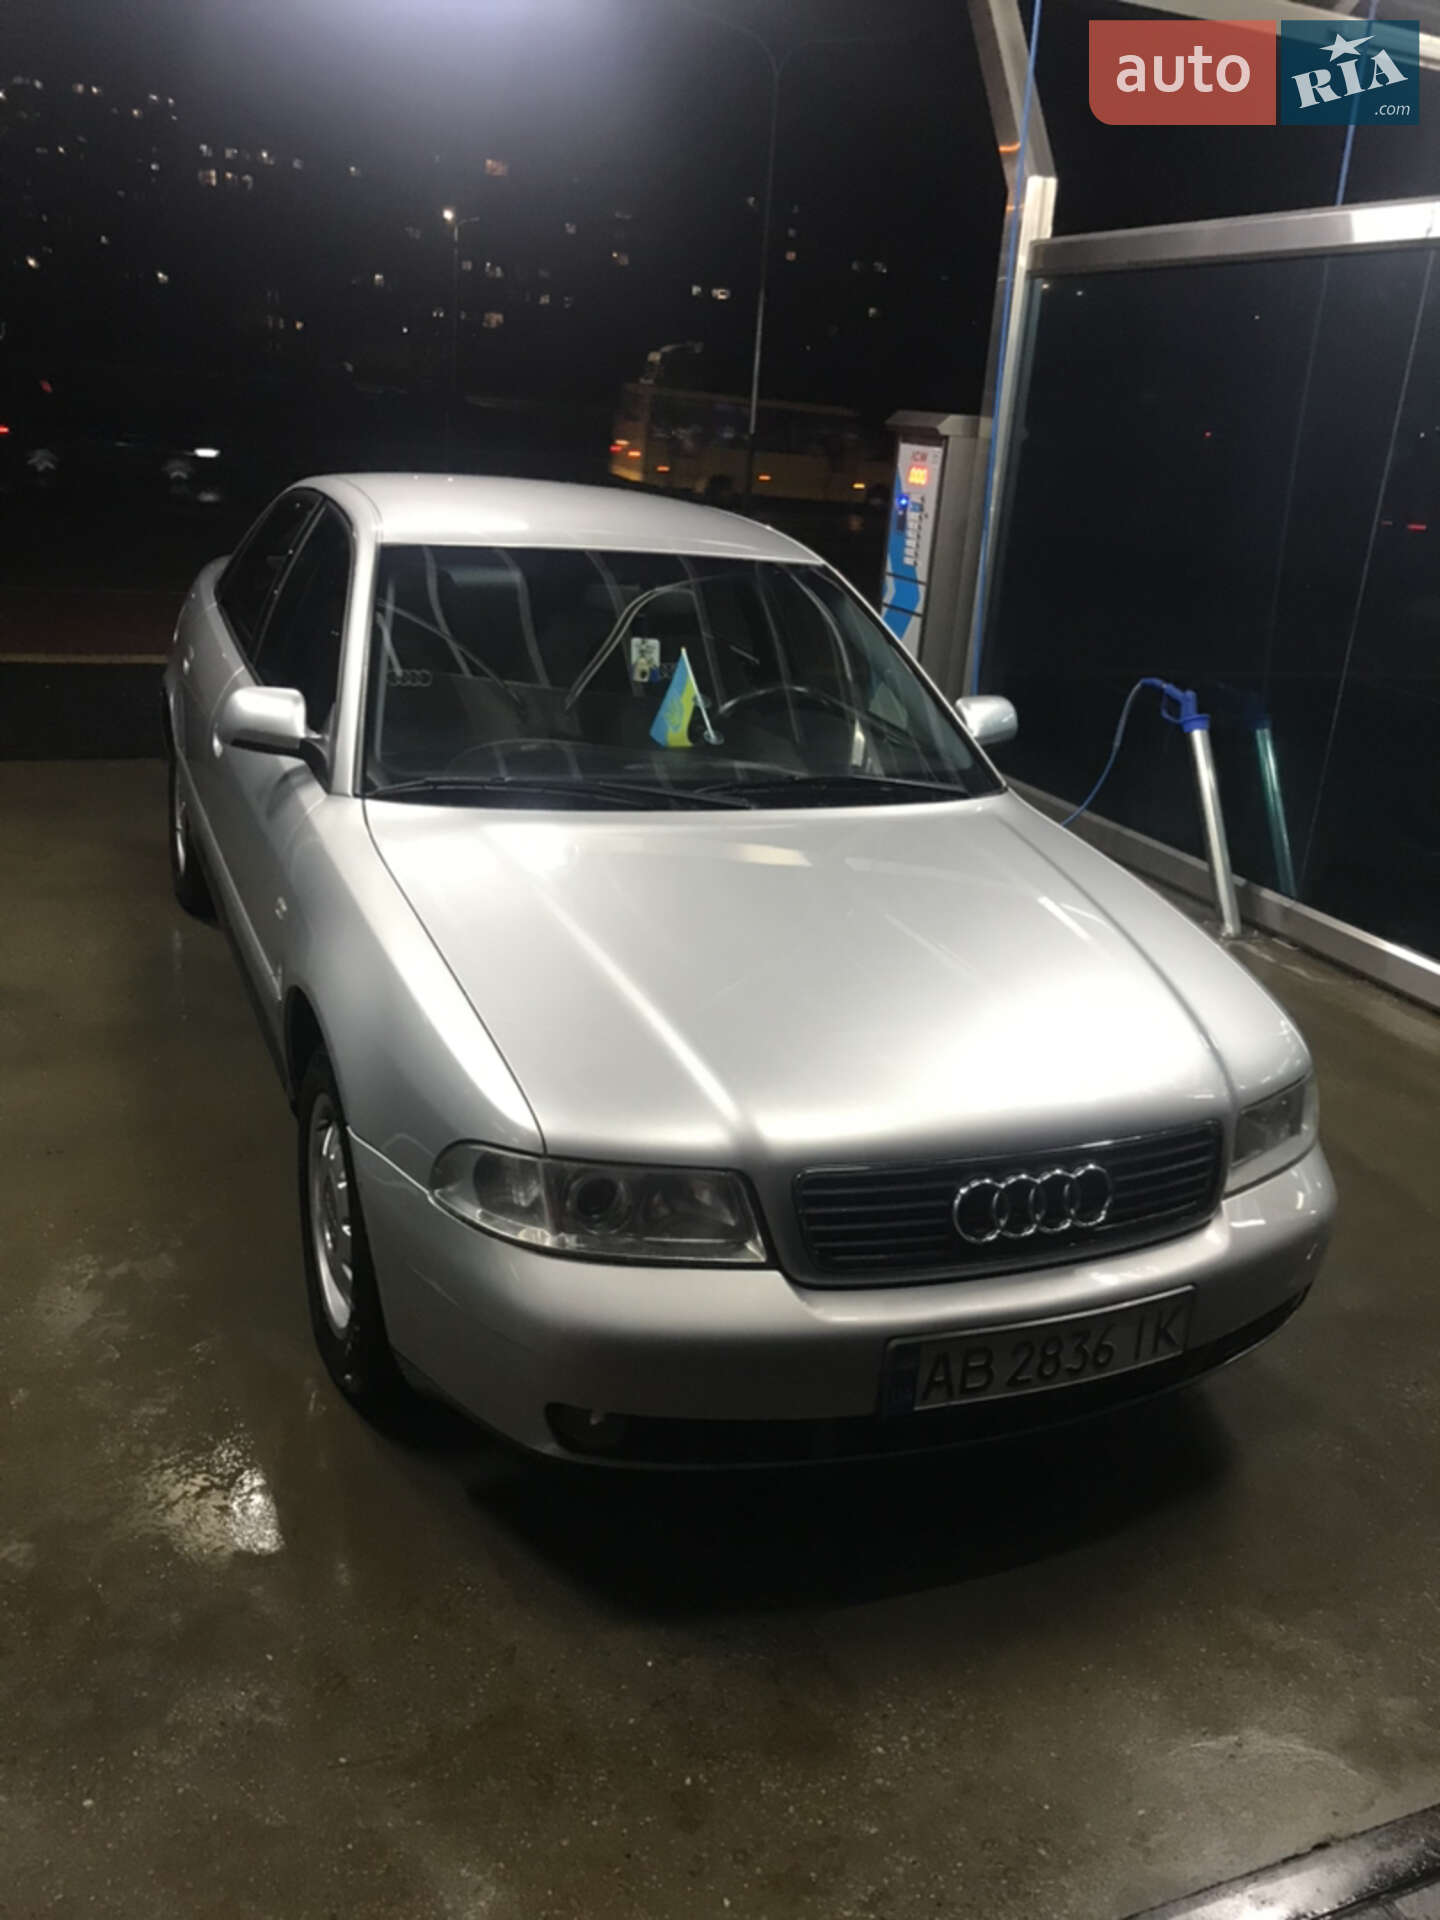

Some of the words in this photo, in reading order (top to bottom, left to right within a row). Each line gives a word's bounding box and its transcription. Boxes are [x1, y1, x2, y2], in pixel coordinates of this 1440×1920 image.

[922, 1345, 995, 1401] AB
[1006, 1322, 1116, 1388] 2836
[1133, 1303, 1182, 1361] IK
